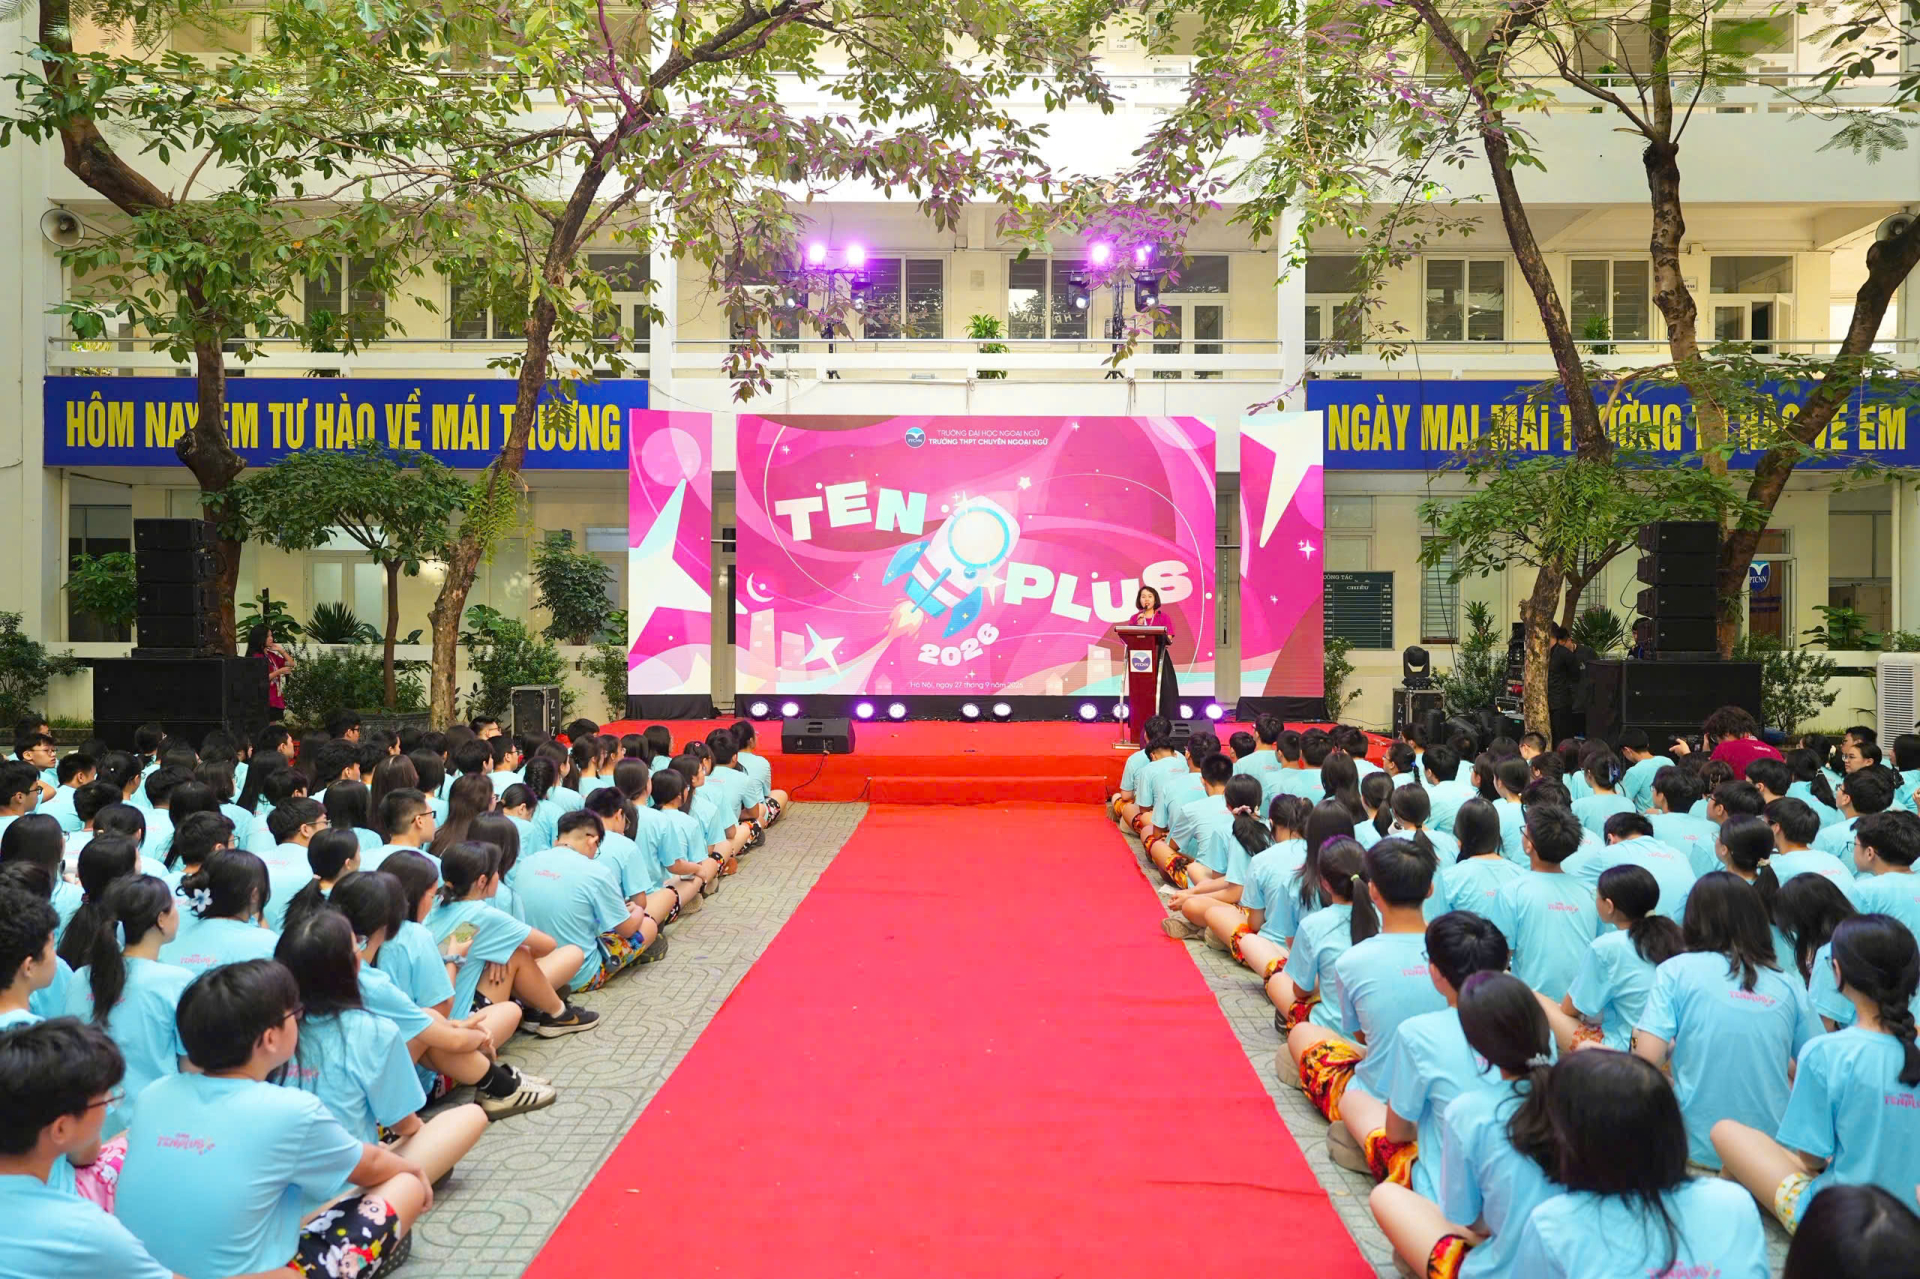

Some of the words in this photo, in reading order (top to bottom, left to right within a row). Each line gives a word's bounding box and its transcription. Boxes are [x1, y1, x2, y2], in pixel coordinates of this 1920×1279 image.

[66, 391, 134, 448] HÔM
[315, 393, 375, 450] HÀO
[385, 388, 421, 450] VỀ
[432, 394, 490, 450] MÁI
[1328, 394, 1411, 451] NGÀY
[1421, 405, 1479, 450] MAI
[1560, 393, 1682, 451] TƯỜNG
[1859, 403, 1906, 450] EM
[774, 480, 928, 542] TEN
[1003, 560, 1194, 624] PLUS
[917, 622, 1000, 667] 2026
